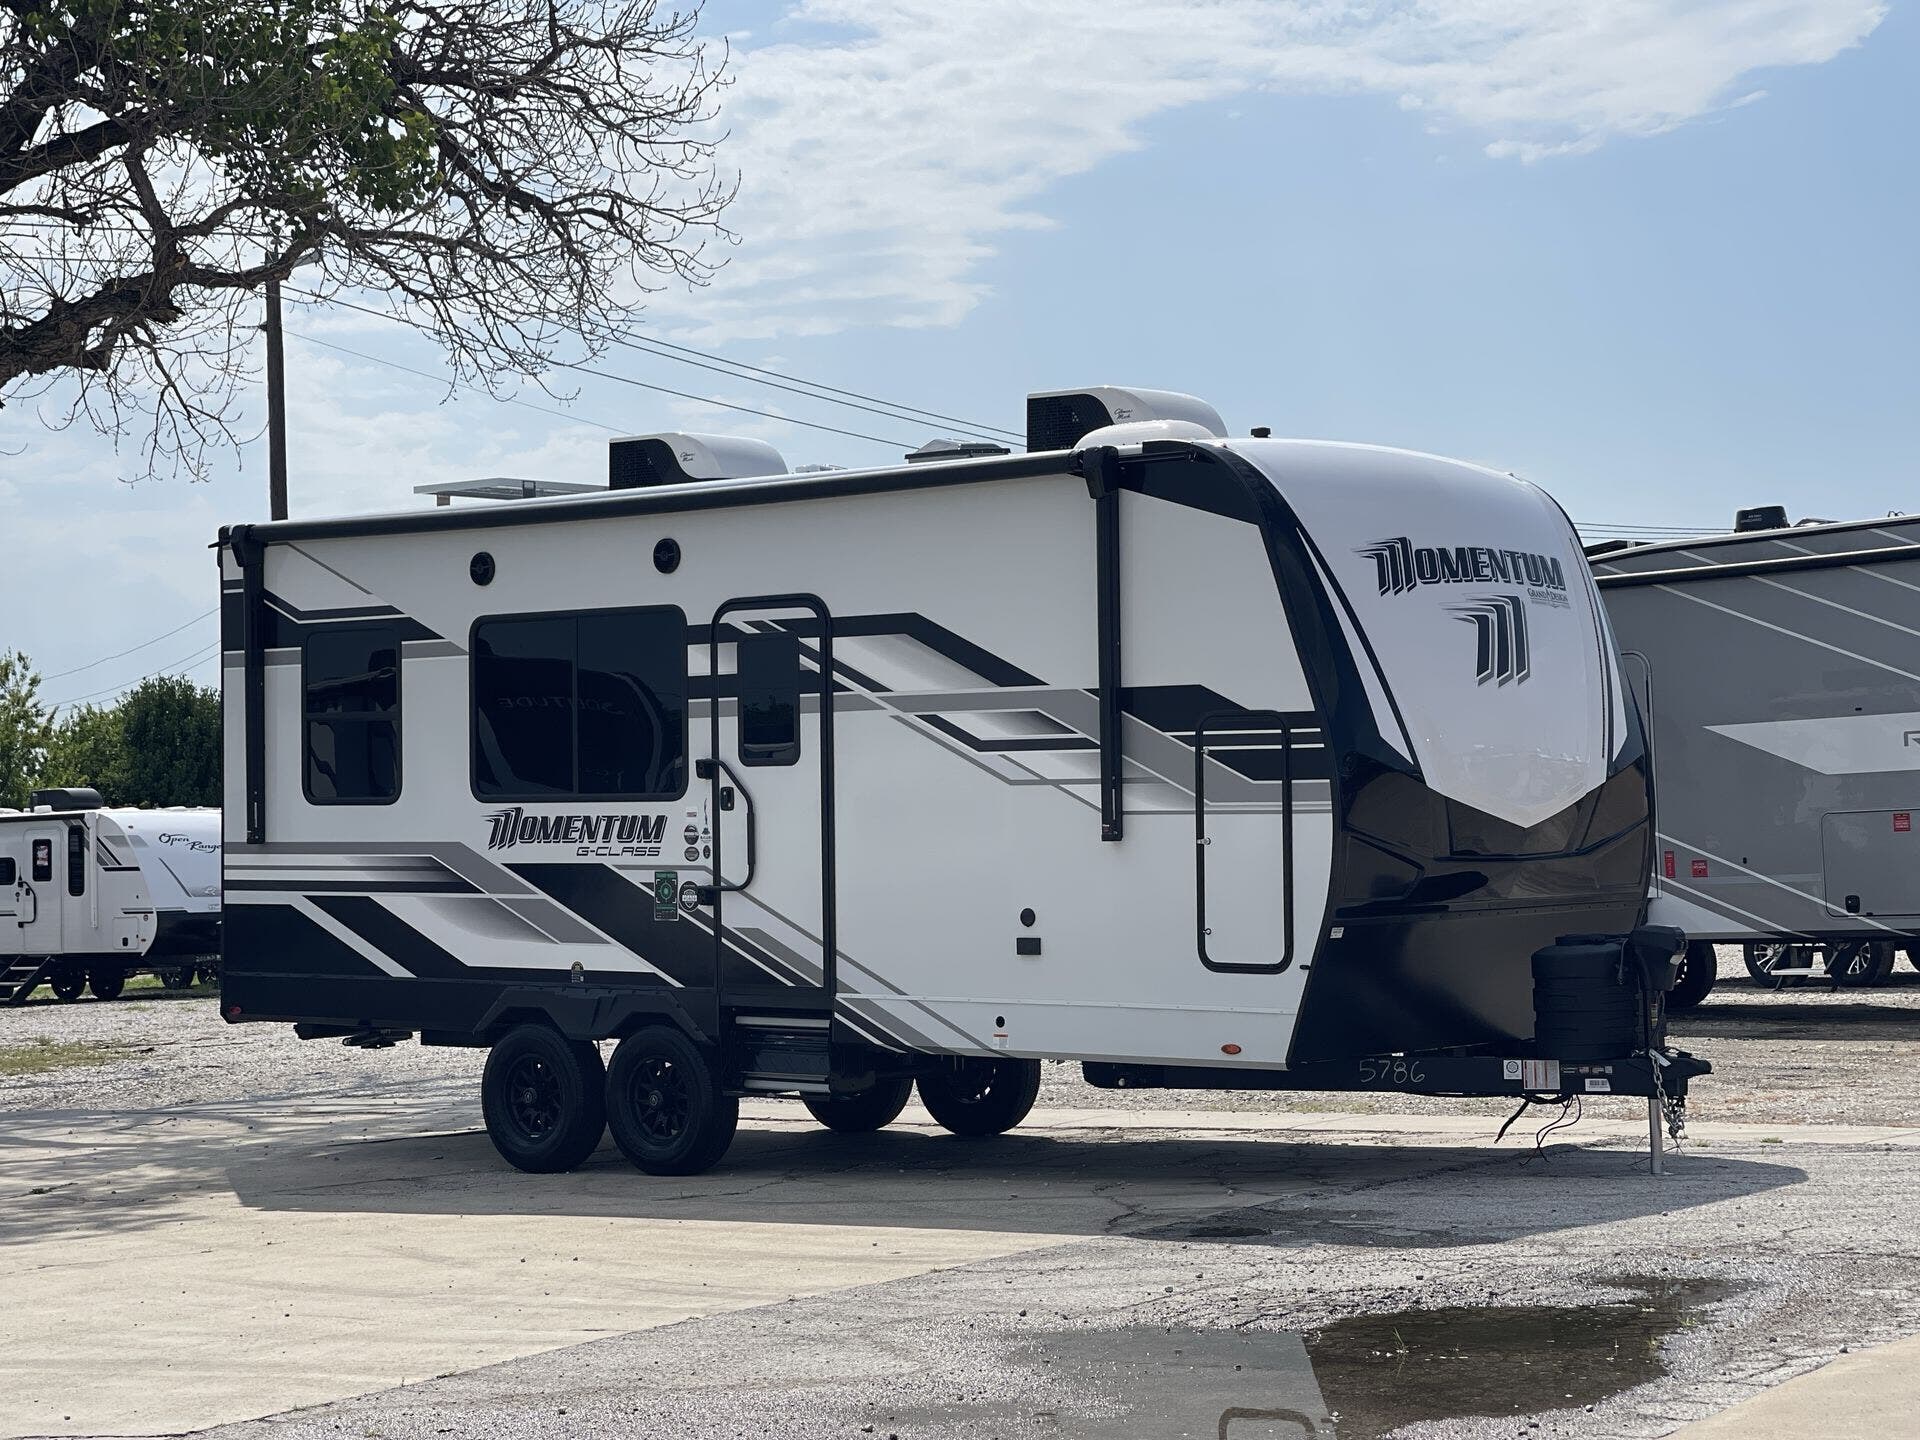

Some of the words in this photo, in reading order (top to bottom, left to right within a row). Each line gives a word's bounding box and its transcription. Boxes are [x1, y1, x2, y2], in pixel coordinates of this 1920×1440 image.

[1352, 537, 1566, 596] MOMENTUM
[158, 833, 190, 846] Open
[480, 806, 667, 850] MOMENTUM
[576, 846, 661, 857] G-CLASS
[1359, 1059, 1426, 1084] 5786
